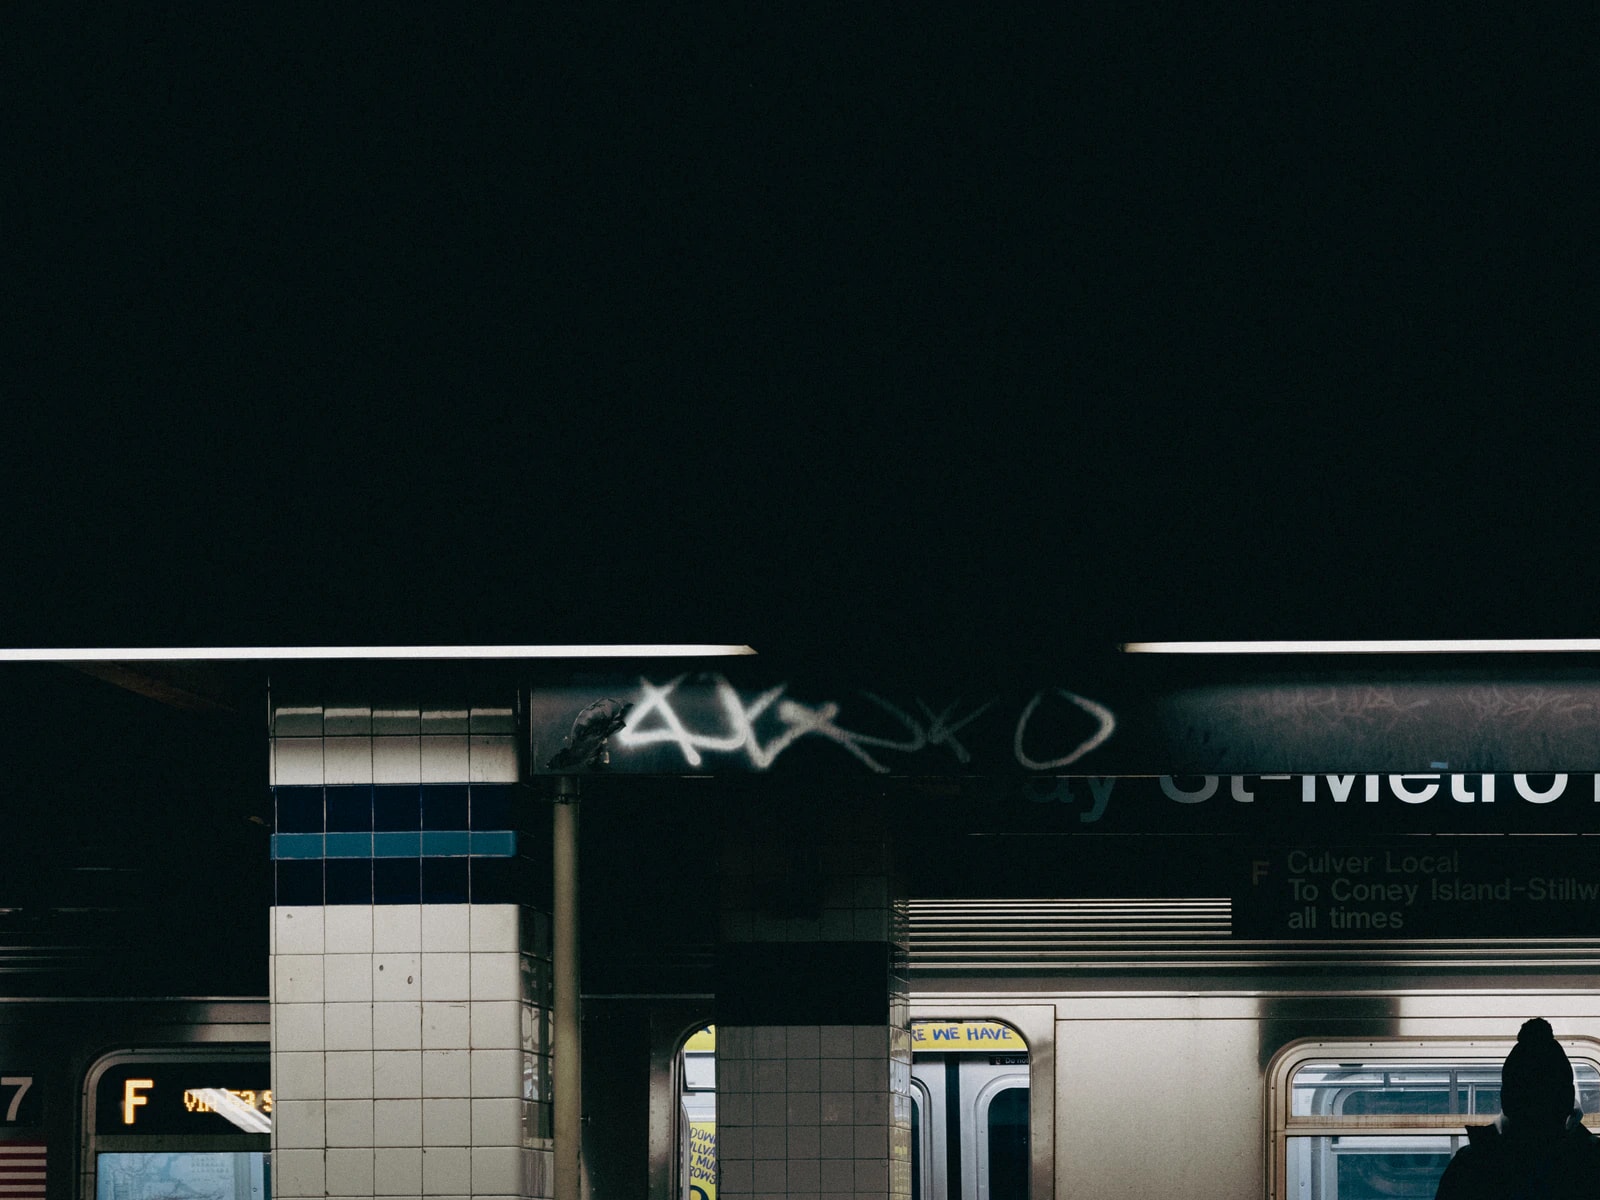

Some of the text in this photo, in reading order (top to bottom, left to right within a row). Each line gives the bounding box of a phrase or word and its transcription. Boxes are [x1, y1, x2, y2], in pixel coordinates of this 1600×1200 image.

[1252, 861, 1270, 885] F
[1287, 850, 1459, 874] Culver Local
[1288, 878, 1319, 902] To
[1330, 878, 1419, 907] Coney
[1287, 906, 1405, 929] all times
[933, 1027, 960, 1040] WE
[967, 1025, 1012, 1041] HAVE
[0, 1076, 33, 1121] 7
[123, 1078, 154, 1125] F
